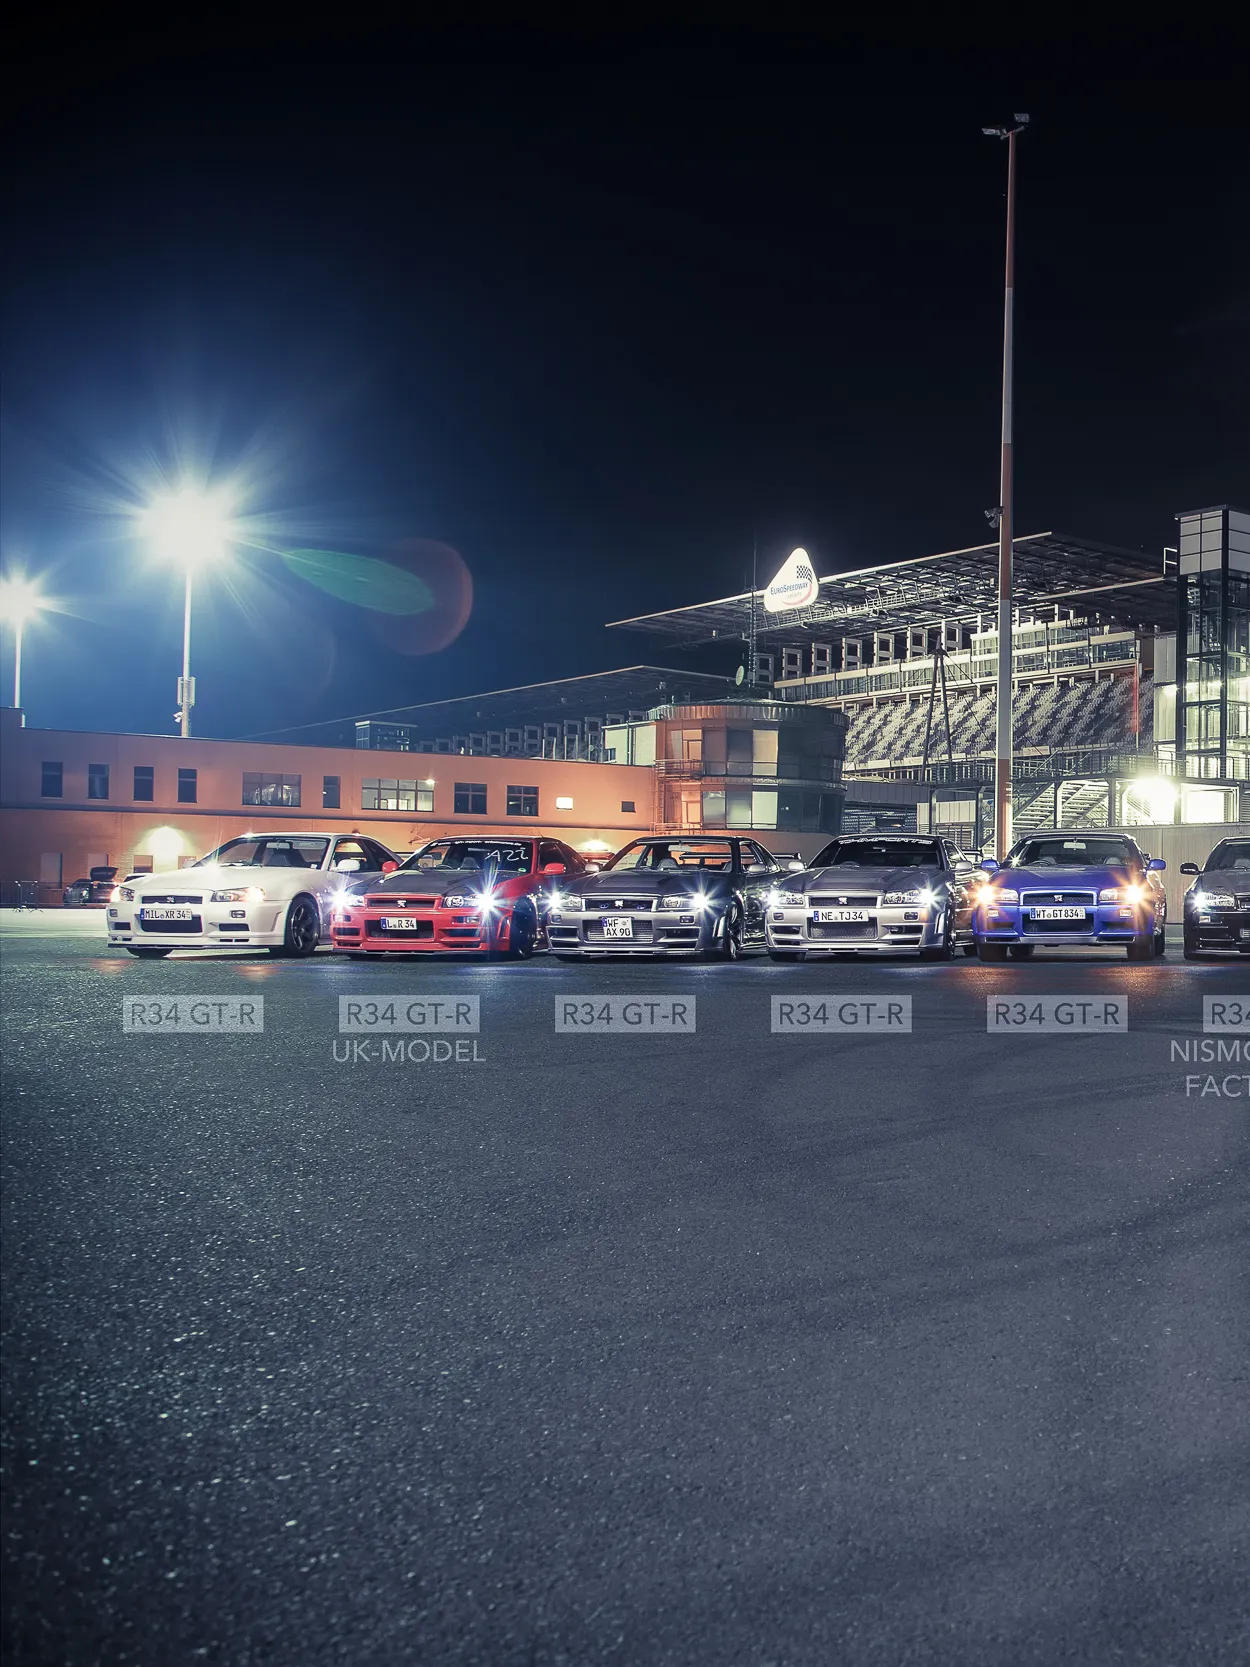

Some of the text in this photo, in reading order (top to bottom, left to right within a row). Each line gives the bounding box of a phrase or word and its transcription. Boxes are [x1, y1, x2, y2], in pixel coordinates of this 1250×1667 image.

[145, 909, 160, 919] MIL
[165, 910, 175, 919] XR
[176, 910, 186, 919] 34
[821, 911, 833, 921] NE
[387, 919, 415, 928] L R 34
[606, 928, 618, 937] AX
